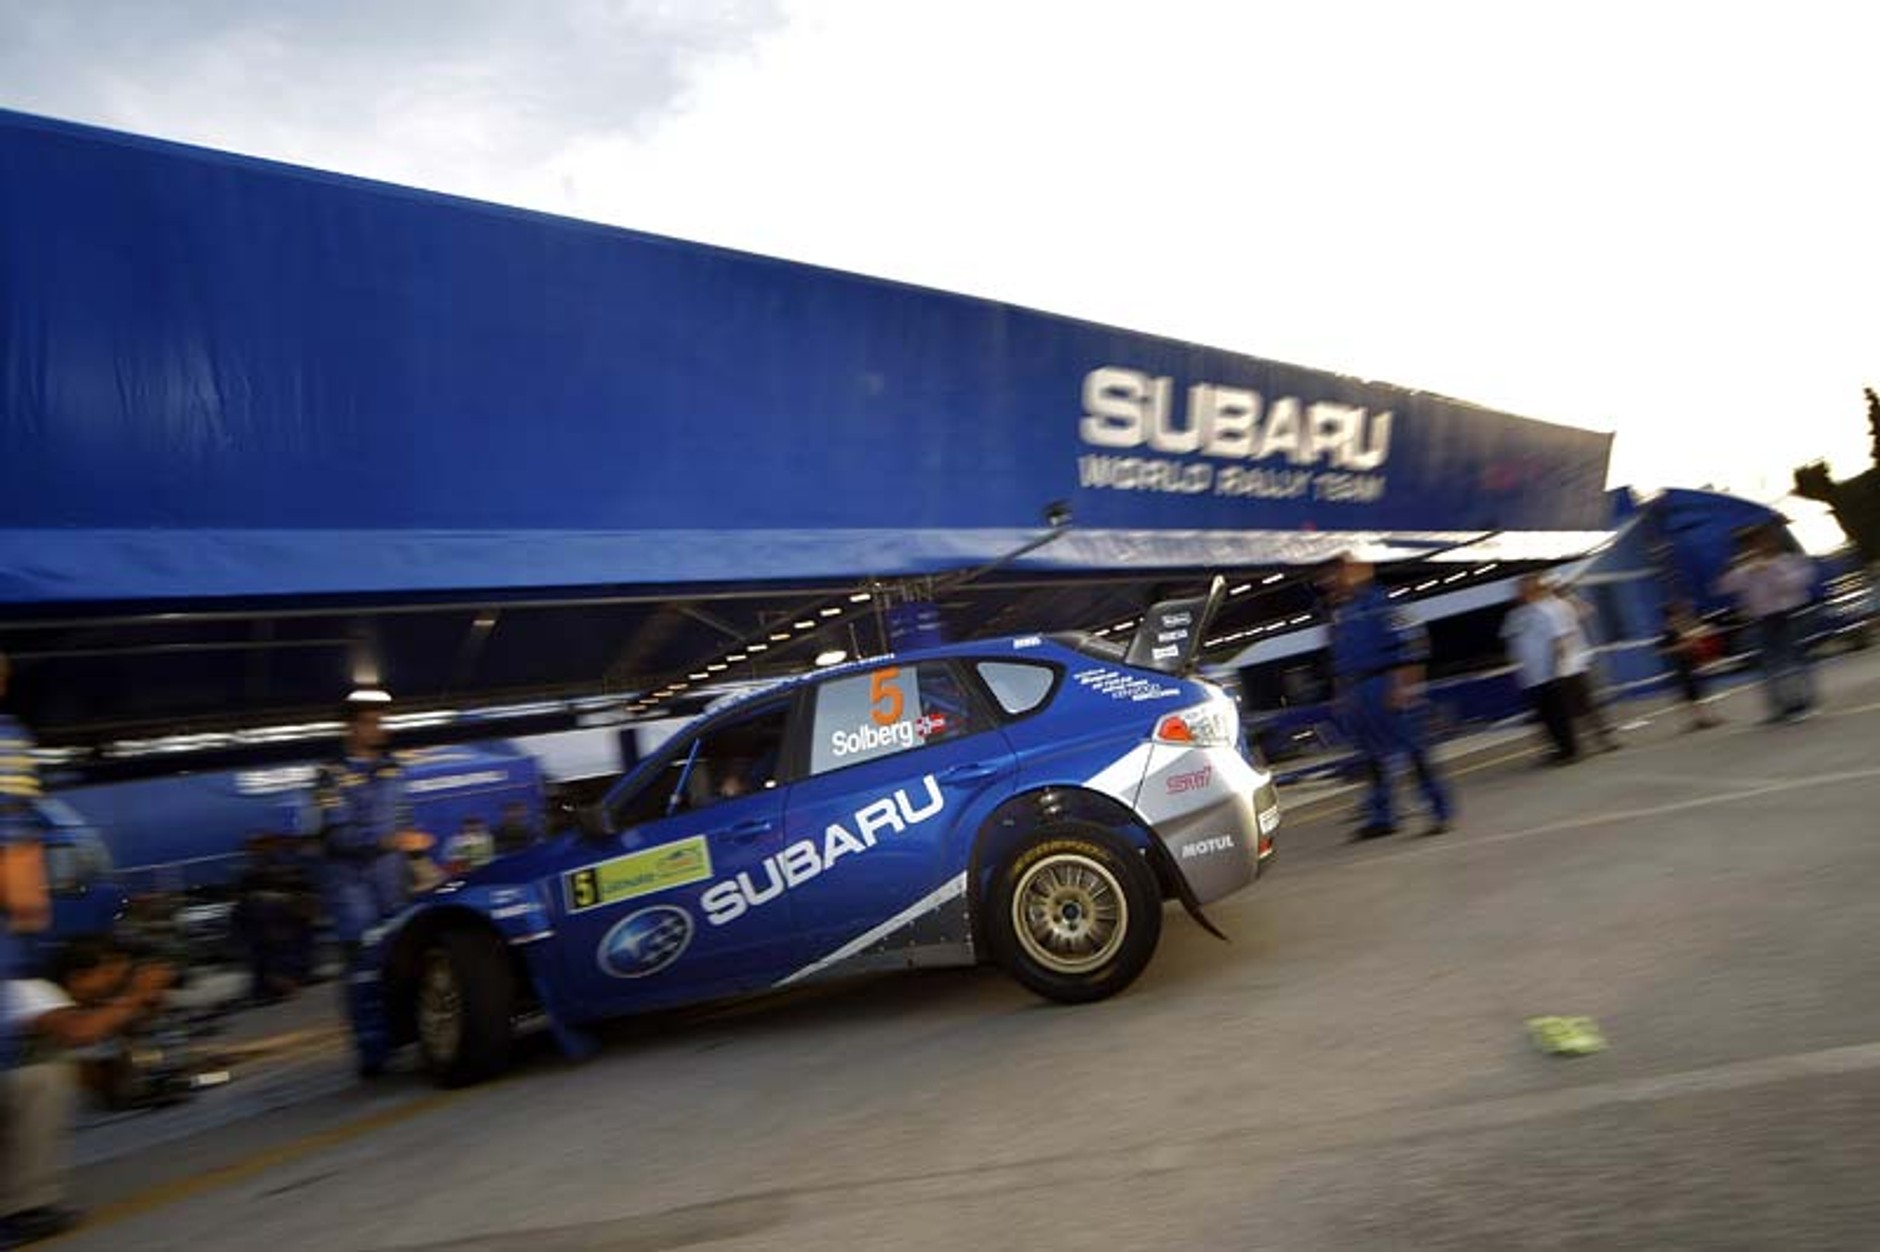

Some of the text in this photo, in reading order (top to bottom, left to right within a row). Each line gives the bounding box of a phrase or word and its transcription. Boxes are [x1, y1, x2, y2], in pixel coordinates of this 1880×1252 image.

[1080, 366, 1393, 471] SUBARU
[1078, 454, 1386, 502] WORLD RALLY TEAM
[870, 667, 904, 725] 5
[832, 721, 913, 756] Solberg
[701, 774, 944, 925] SUBARU
[1182, 835, 1234, 858] MOTUL
[573, 872, 597, 906] 5
